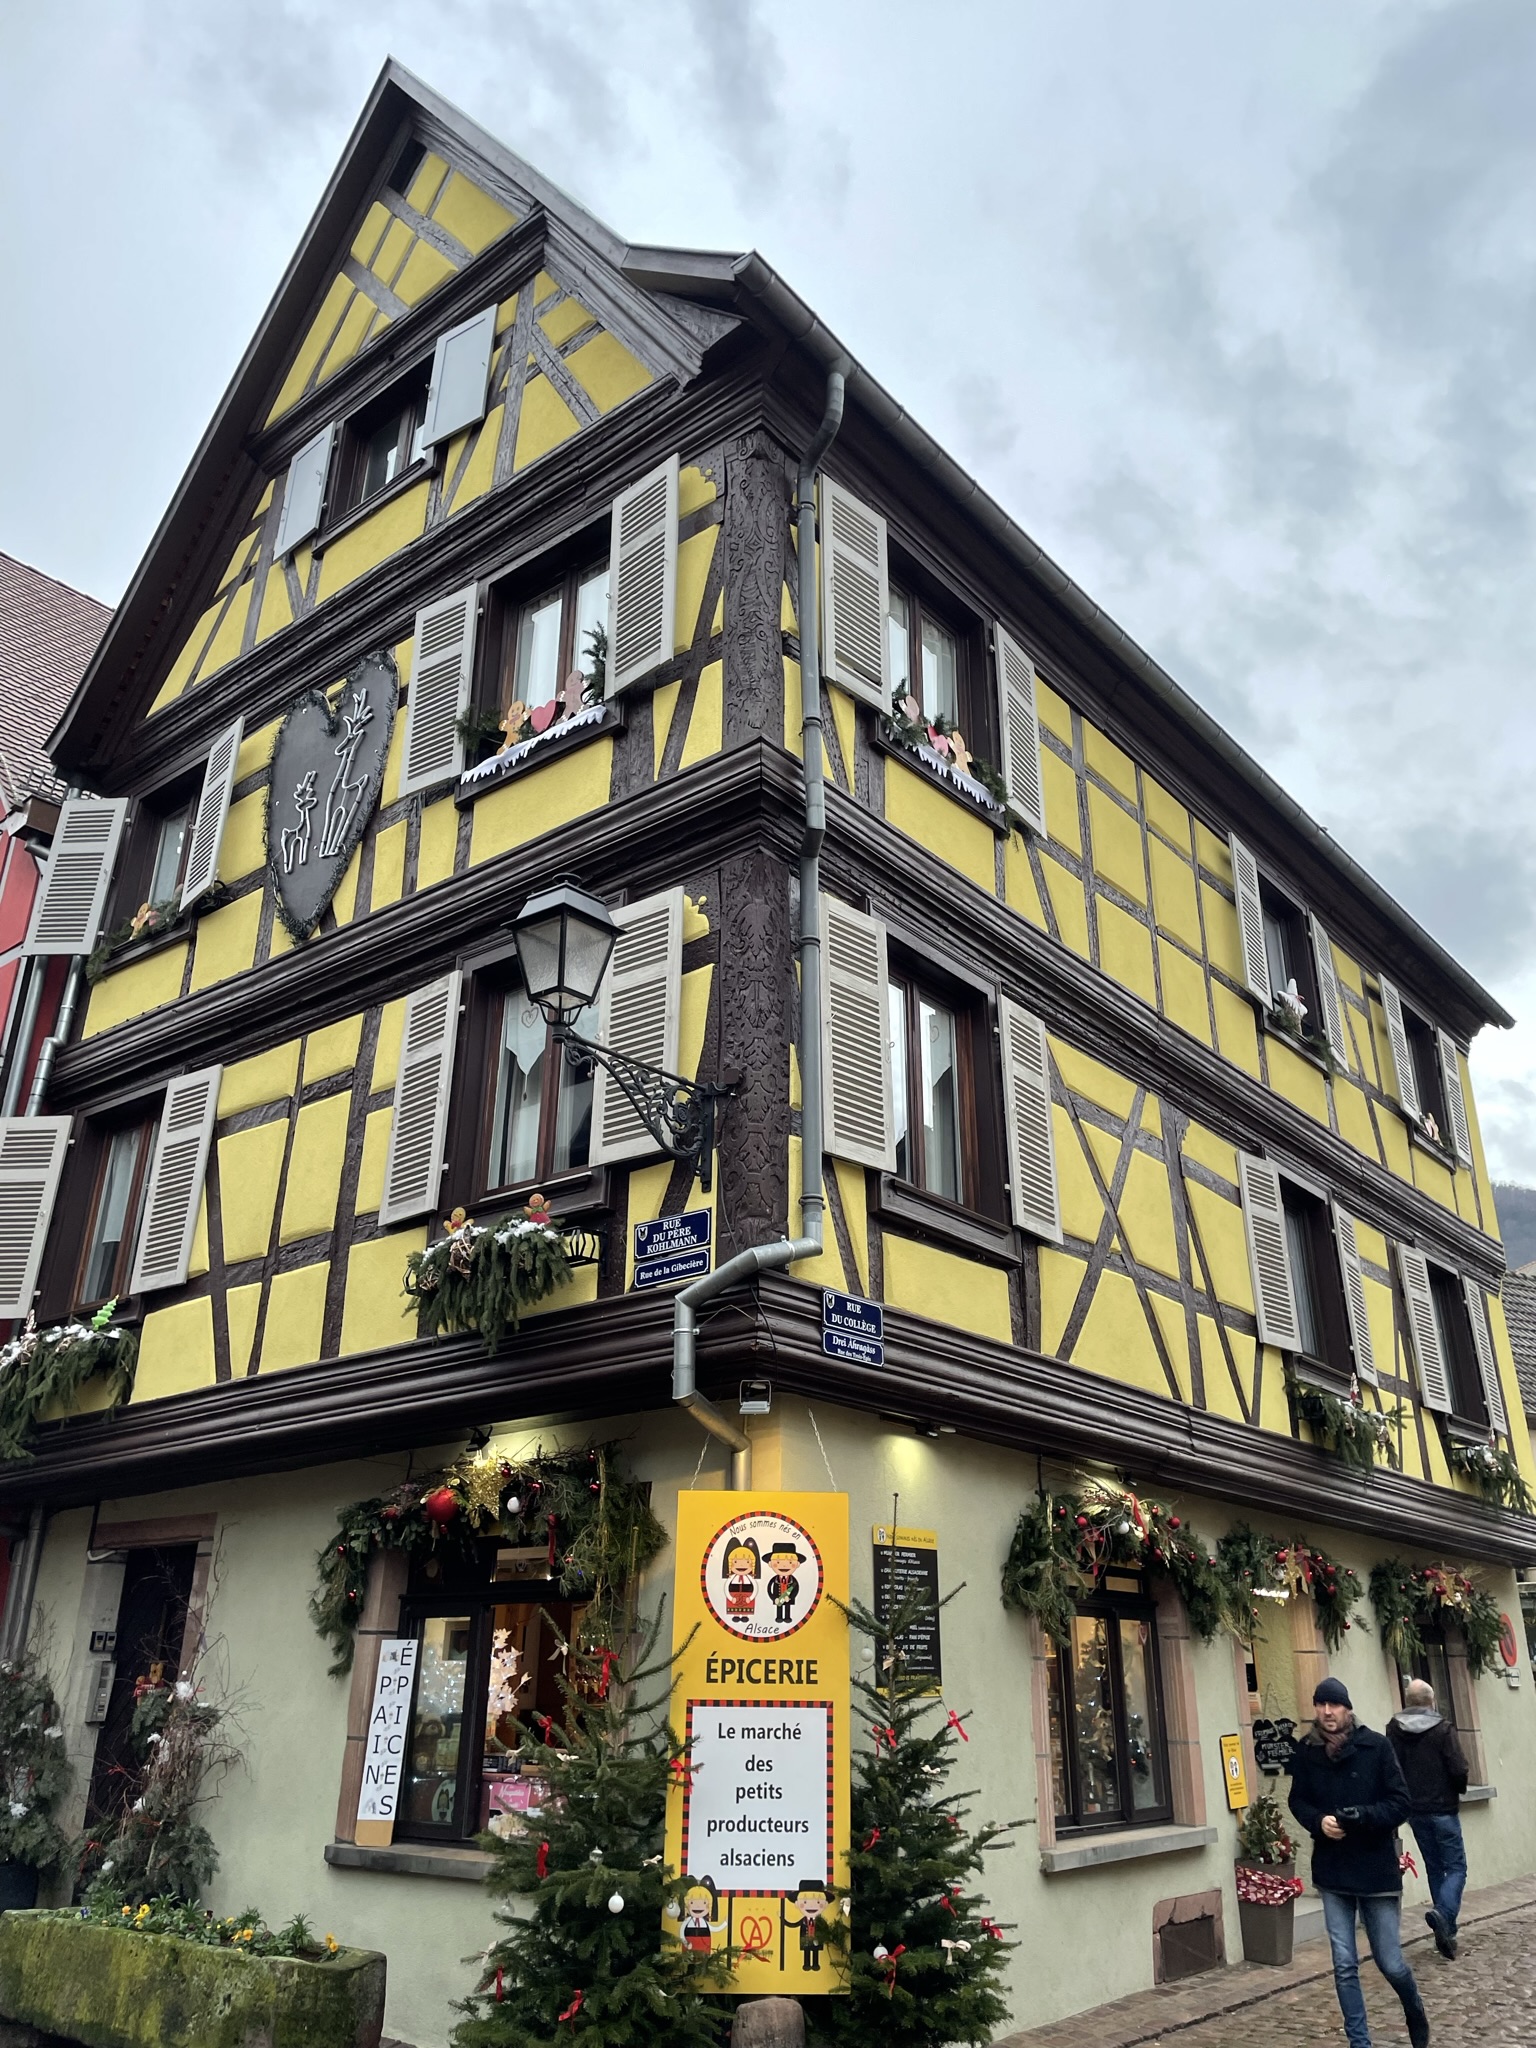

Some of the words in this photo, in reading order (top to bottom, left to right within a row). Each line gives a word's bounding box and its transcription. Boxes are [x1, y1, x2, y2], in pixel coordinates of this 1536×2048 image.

[663, 1218, 682, 1231] RUE
[646, 1234, 698, 1255] KOHLMANN
[652, 1231, 666, 1244] DU
[667, 1226, 692, 1240] PÈRE
[640, 1271, 653, 1280] Rue
[653, 1268, 663, 1277] de
[663, 1266, 670, 1275] la
[671, 1259, 704, 1273] Gibecière
[846, 1301, 862, 1314] RUE
[831, 1313, 843, 1325] DU
[843, 1316, 877, 1334] COLLÈGE
[832, 1335, 847, 1347] Drei
[729, 1523, 748, 1537] Nous
[749, 1520, 777, 1529] sommes
[778, 1523, 792, 1535] nés
[791, 1531, 802, 1541] en
[744, 1622, 780, 1635] Alsace
[705, 1650, 819, 1685] ÉPICERIE
[717, 1722, 736, 1739] Le
[740, 1722, 802, 1740] marché
[745, 1754, 773, 1772] des
[735, 1781, 783, 1804] petits
[707, 1814, 809, 1838] producteurs
[719, 1847, 796, 1867] alsaciens
